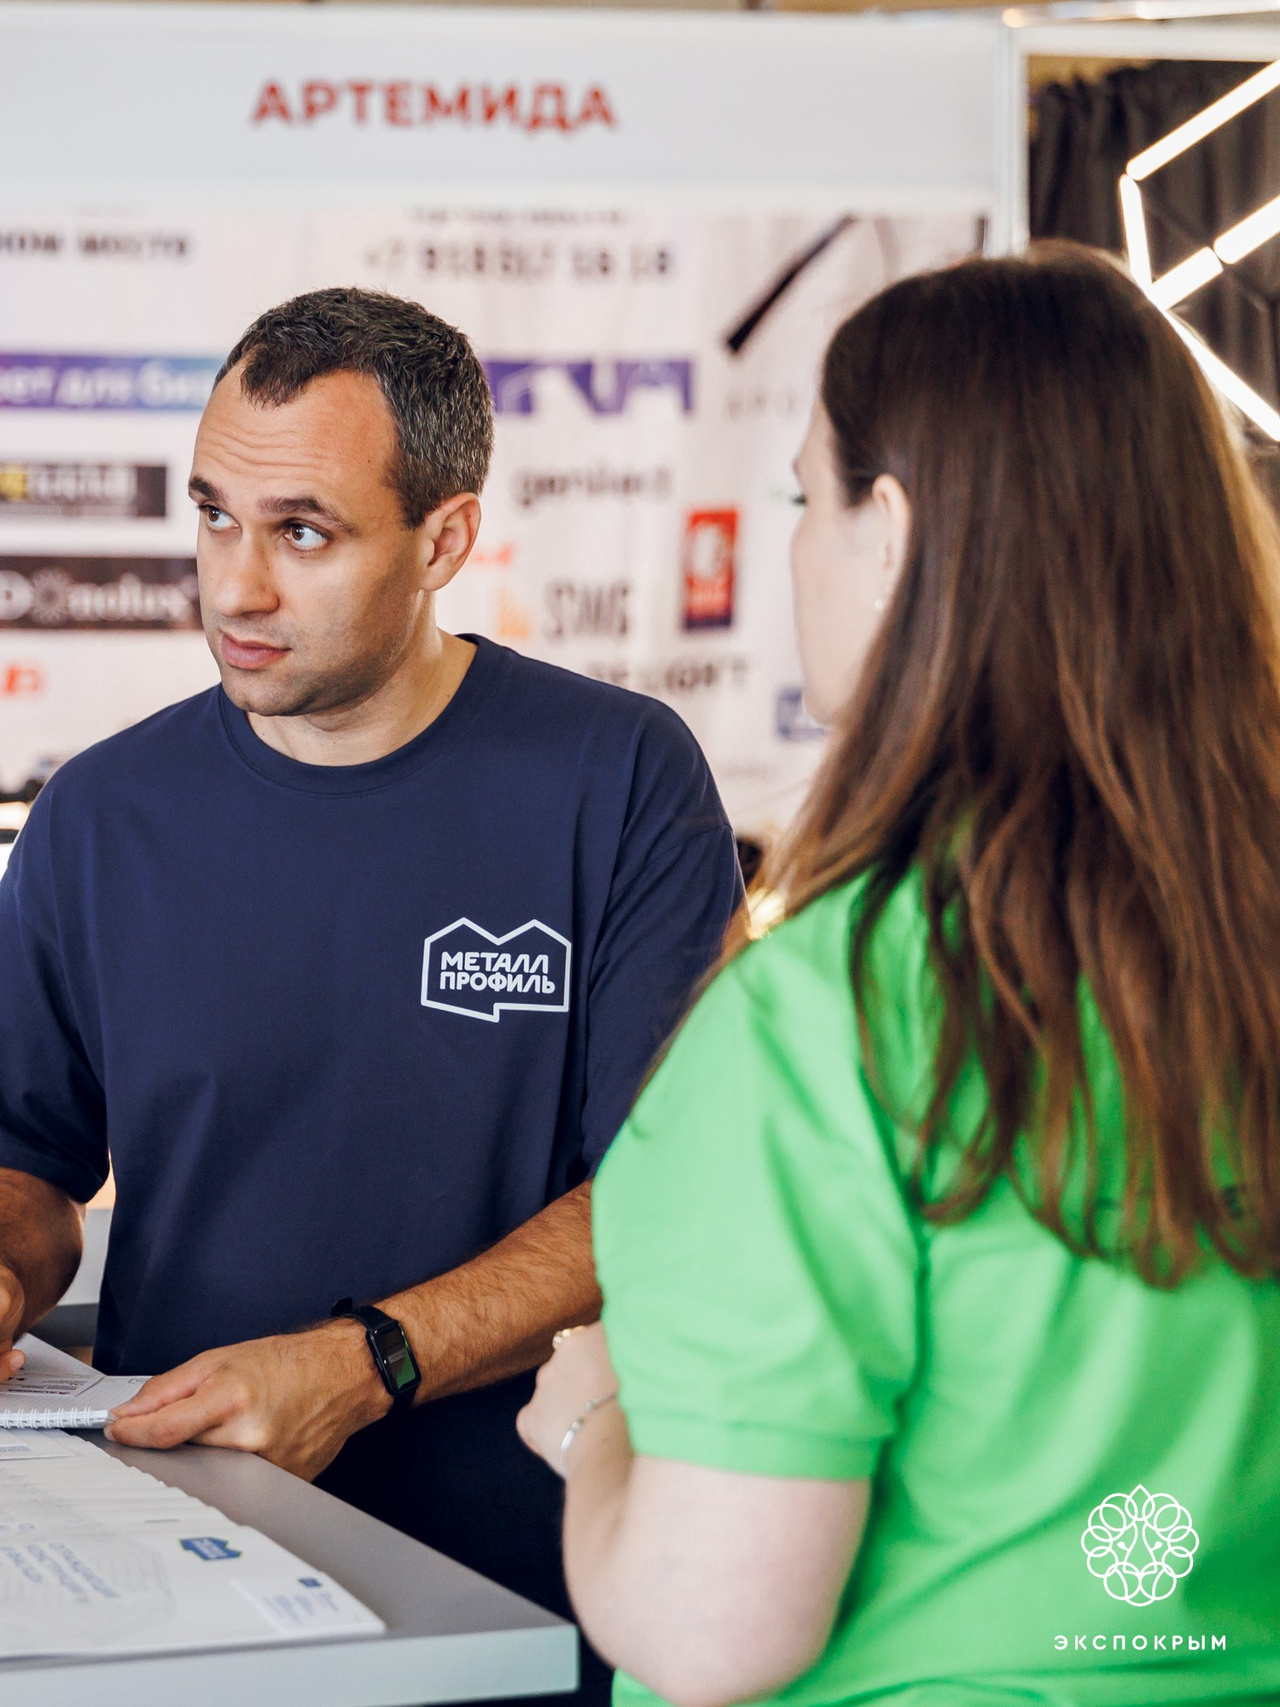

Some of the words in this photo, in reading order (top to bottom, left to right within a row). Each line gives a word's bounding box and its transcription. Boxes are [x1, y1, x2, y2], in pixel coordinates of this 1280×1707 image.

[252, 79, 618, 136] АРТЕМИДА
[440, 951, 549, 975] МЕТАЛЛ
[439, 971, 556, 995] ПРОФИЛЬ
